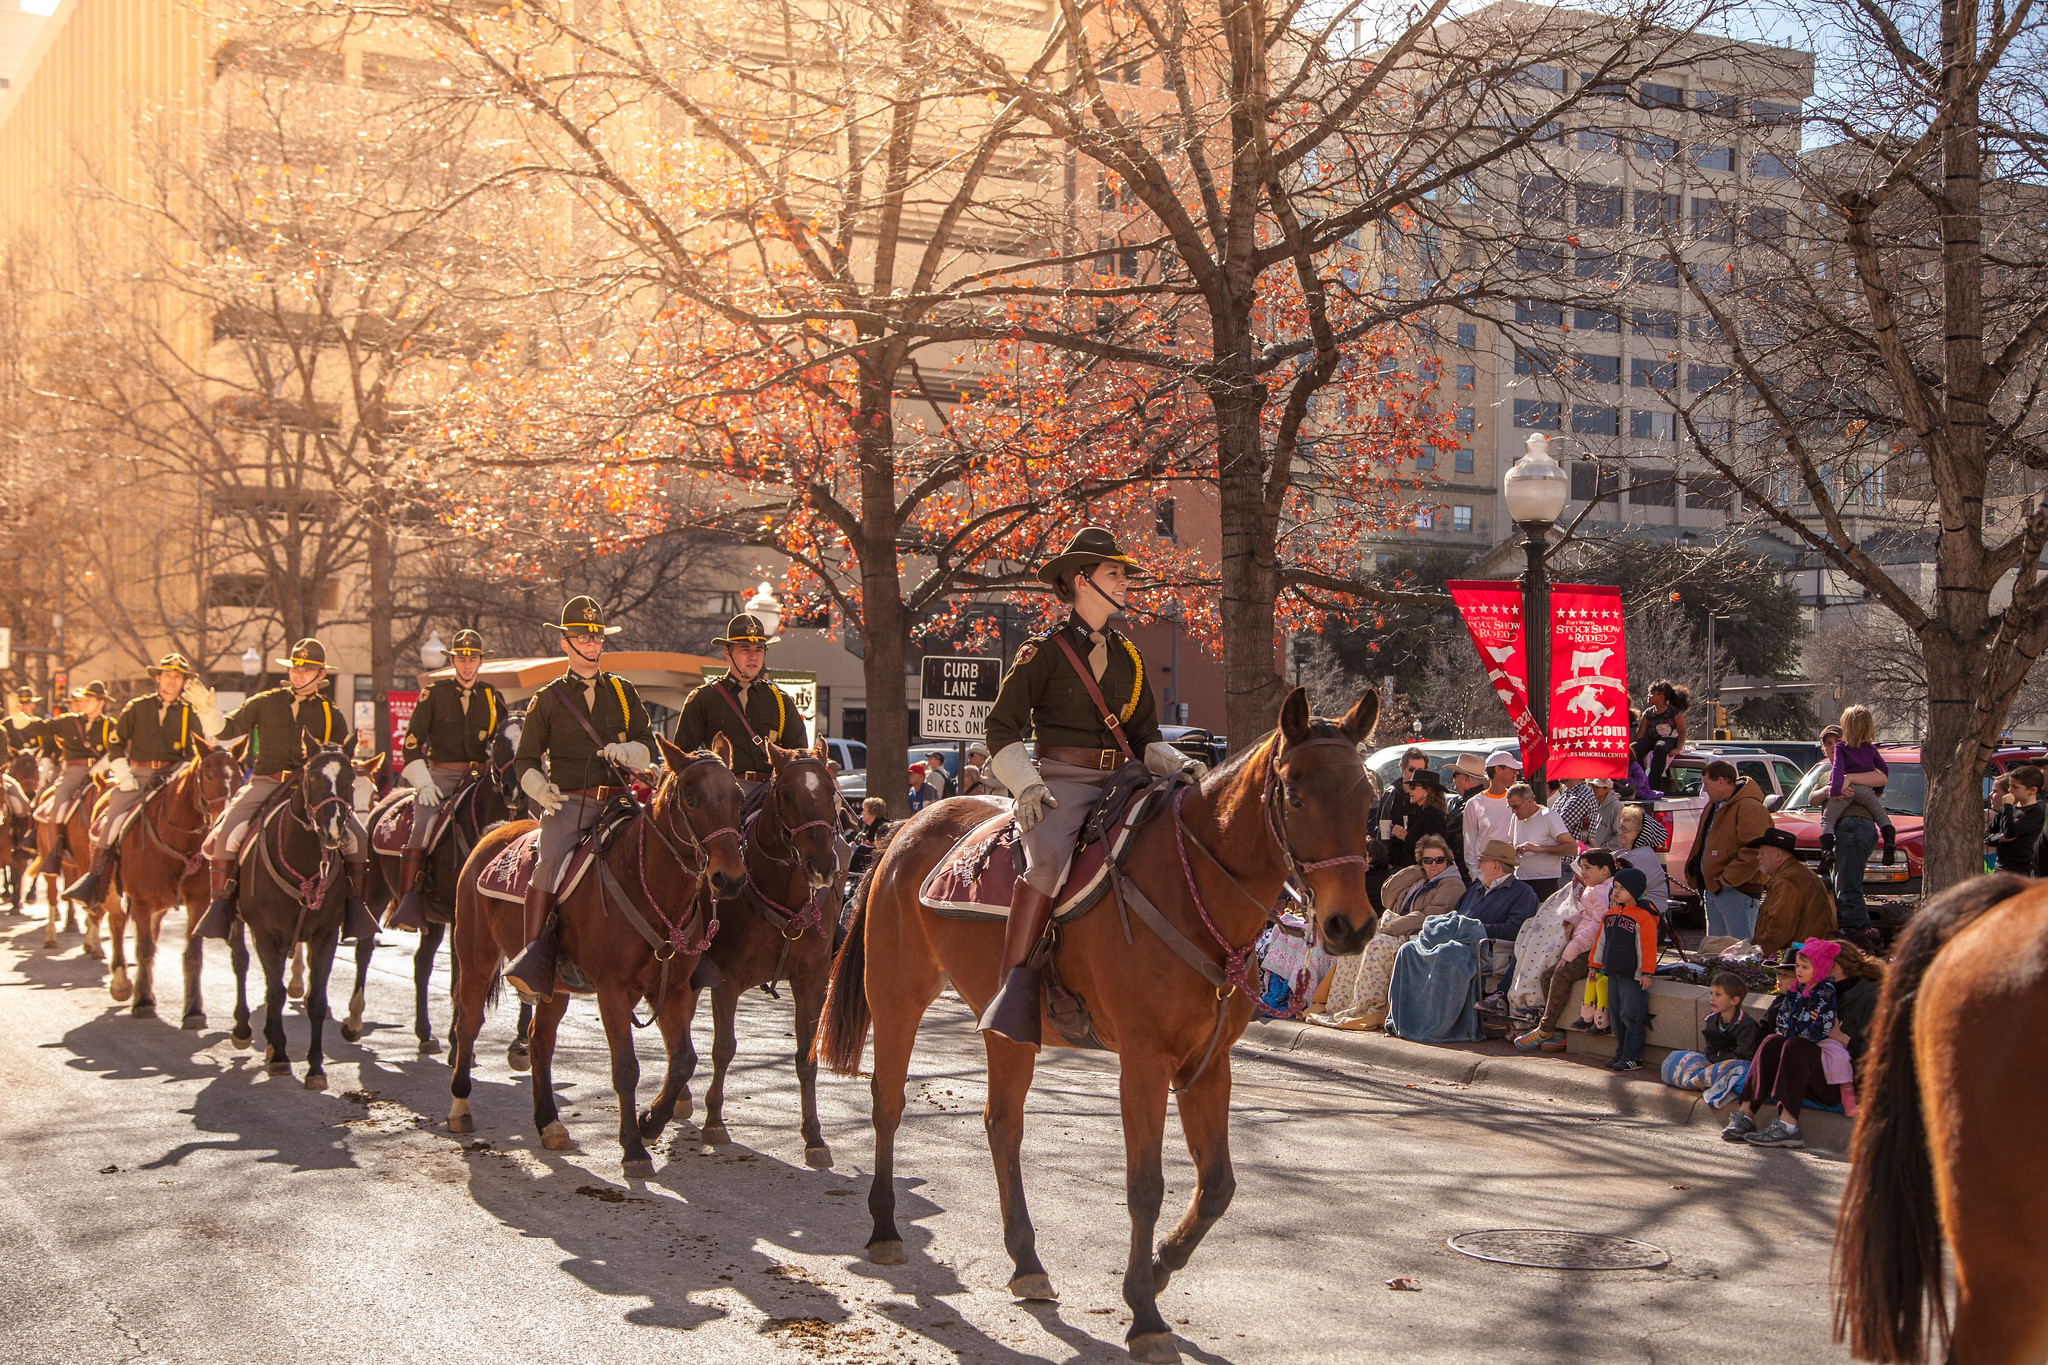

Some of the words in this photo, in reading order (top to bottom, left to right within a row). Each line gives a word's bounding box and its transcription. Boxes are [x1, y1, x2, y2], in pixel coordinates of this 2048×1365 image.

[1494, 621, 1520, 631] SHOW
[1556, 625, 1590, 634] STOCK
[1591, 625, 1620, 634] SHOW
[943, 662, 979, 678] CURB
[943, 680, 977, 697] LANE
[928, 703, 964, 717] BUSES
[969, 705, 991, 718] AND
[927, 719, 959, 733] BIKES
[965, 721, 986, 734] ONL
[1552, 725, 1627, 739] fwssr.com
